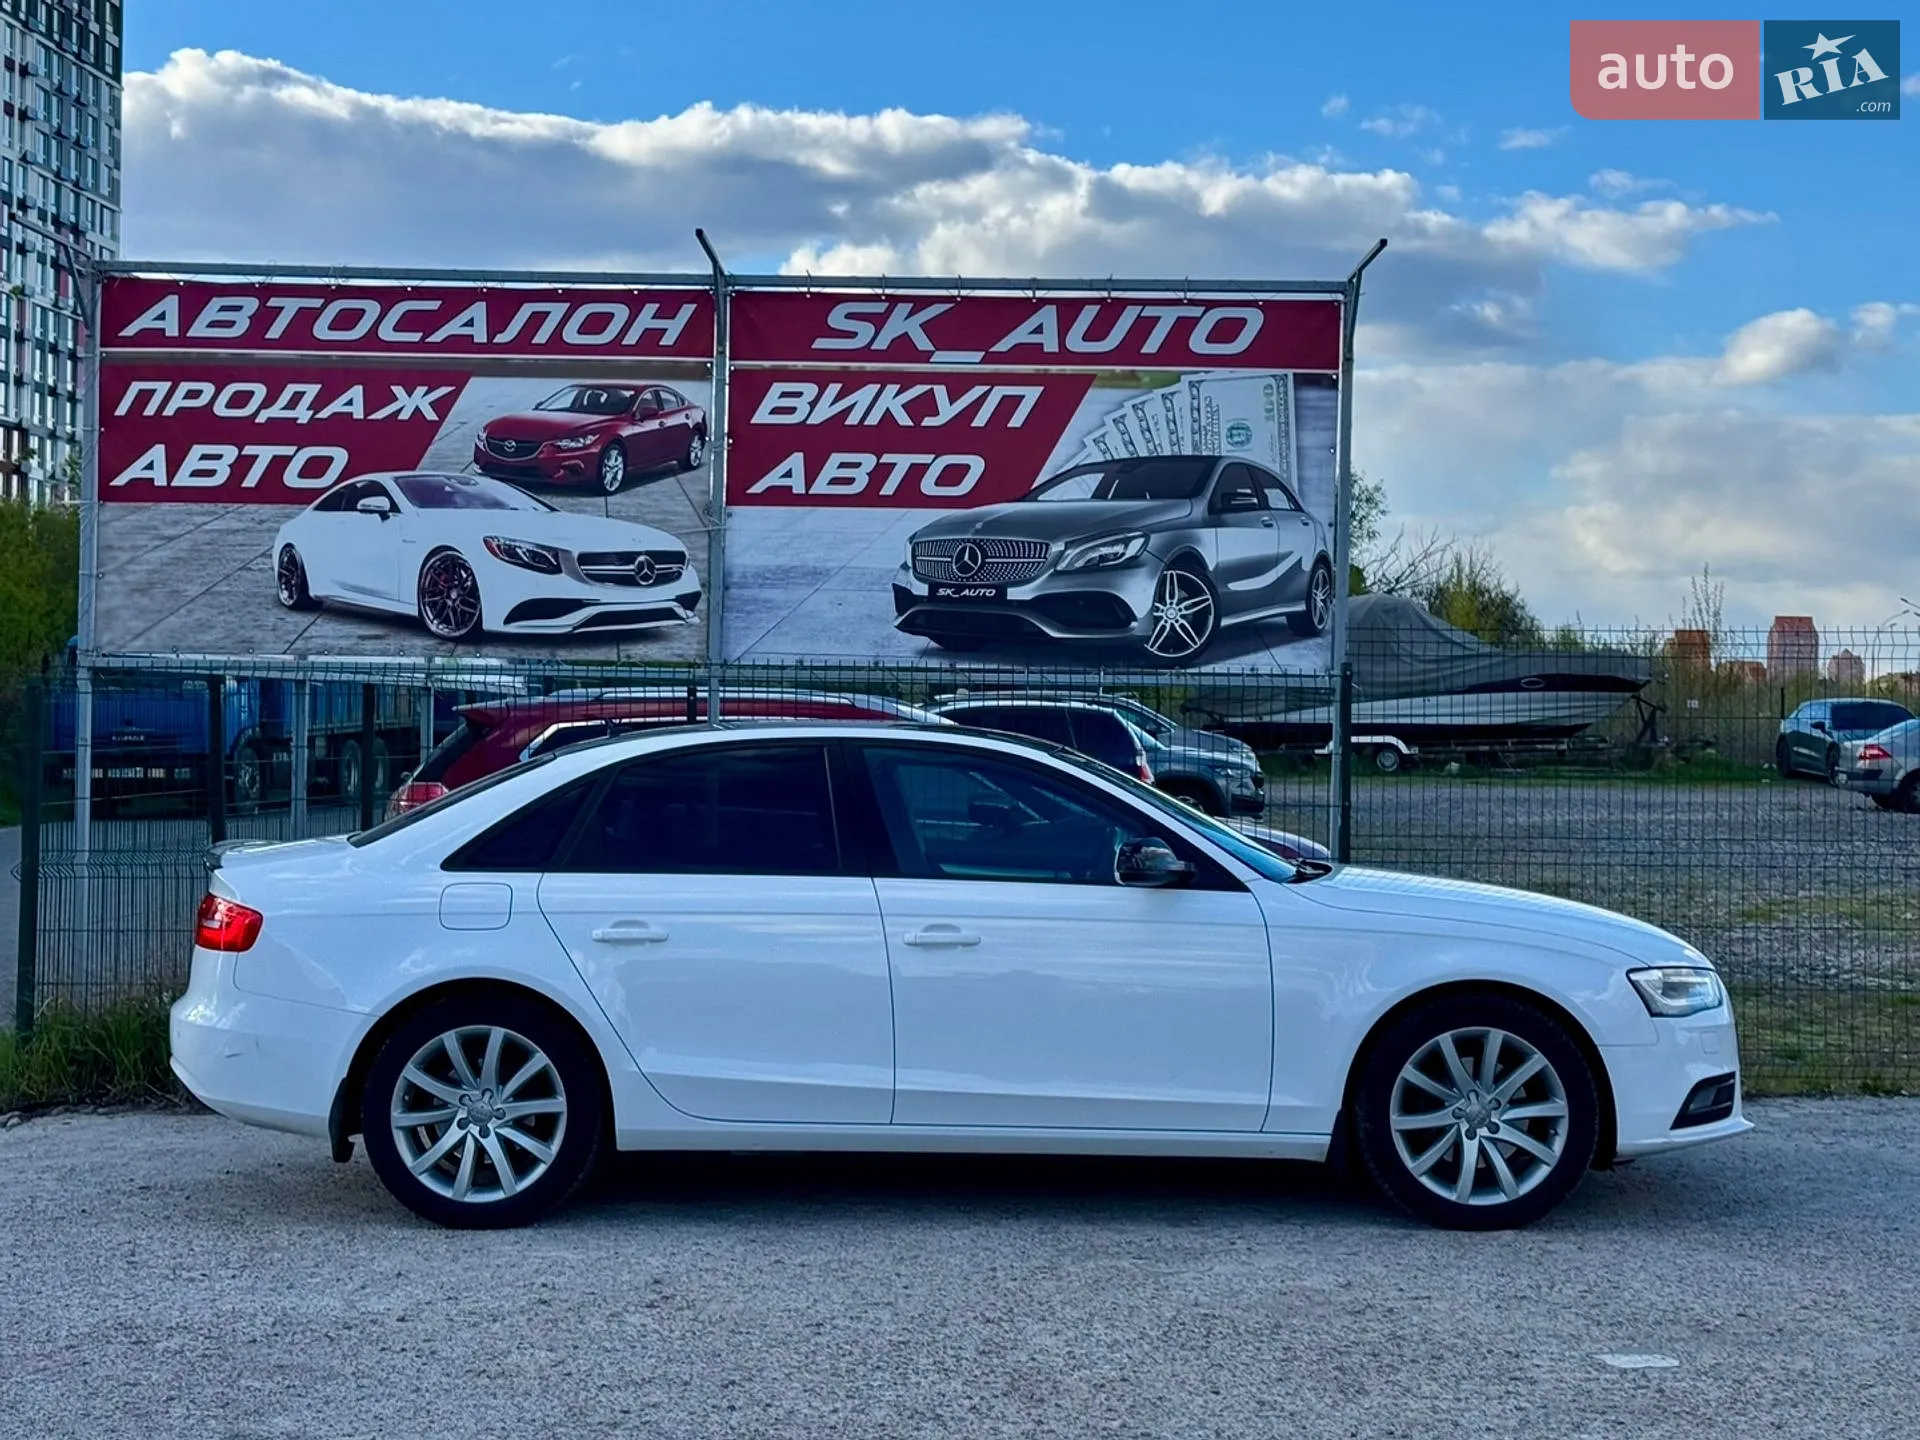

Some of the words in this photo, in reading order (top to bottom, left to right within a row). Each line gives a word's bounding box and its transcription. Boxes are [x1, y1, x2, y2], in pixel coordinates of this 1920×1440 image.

[118, 294, 698, 347] АВТОСАЛОН
[811, 301, 1265, 363] SK_AUTO
[114, 381, 456, 424] ПРОДАЖ
[750, 382, 1045, 428] ВИКУП
[109, 444, 350, 489] АВТО
[746, 452, 985, 496] АВТО
[936, 587, 996, 597] SK_AUTO
